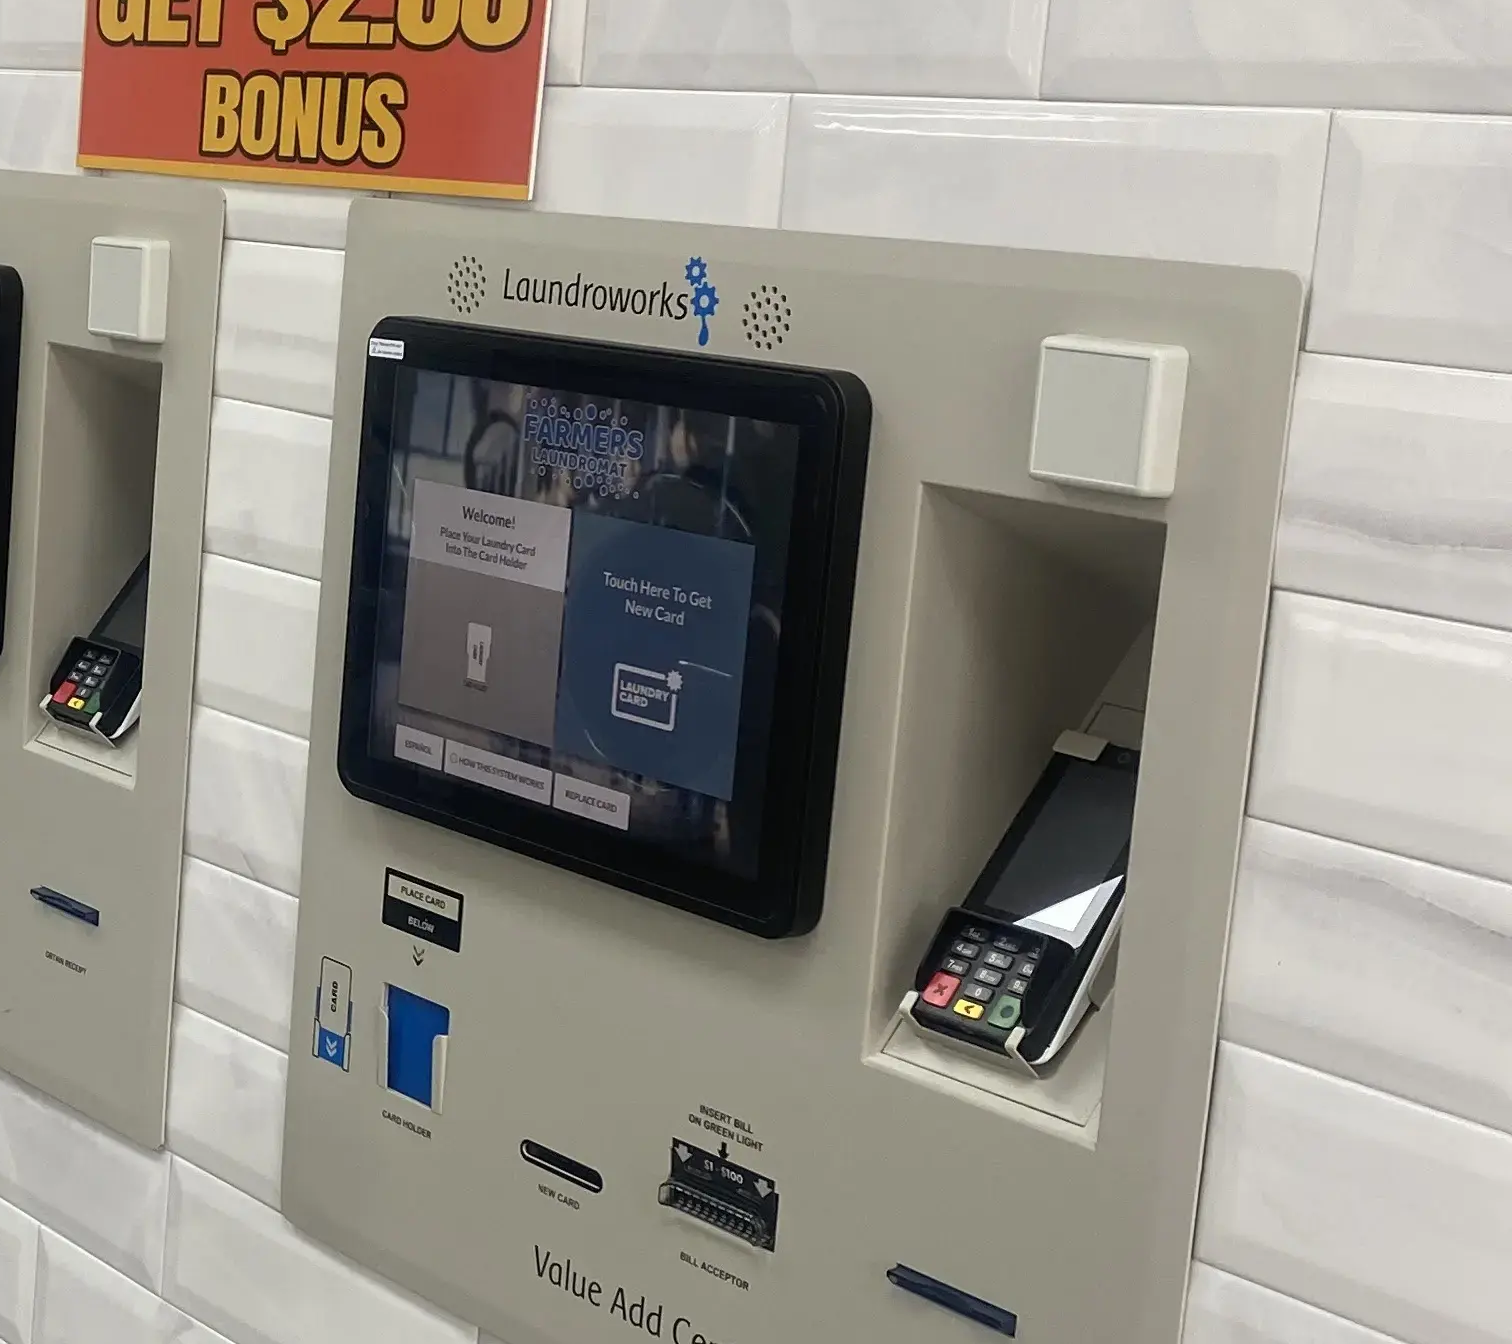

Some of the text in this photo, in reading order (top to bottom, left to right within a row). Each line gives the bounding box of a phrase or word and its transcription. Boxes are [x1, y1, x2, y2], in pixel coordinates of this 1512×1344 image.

[199, 69, 407, 168] BONUS
[502, 268, 688, 321] Laundroworks
[523, 412, 644, 460] FARMERS
[532, 446, 628, 478] LAUNDROMAT
[462, 505, 516, 530] Welcome!
[440, 526, 537, 557] Place Your Laundry Card
[445, 542, 528, 570] Into The Card Holder
[603, 571, 712, 609] Touch Here To Get
[625, 599, 685, 626] New Card
[619, 692, 648, 708] CARD
[620, 680, 670, 702] LAUNDRY
[458, 756, 545, 791] HOW THIS SYSTEM WORKS
[565, 789, 618, 813] REPLACE CARD
[400, 885, 446, 910] PLACE CARD
[408, 915, 435, 933] BELOW
[330, 980, 339, 1012] CARD
[382, 1109, 432, 1140] CARD HOLDER
[688, 1113, 764, 1152] ON GREEN LIGHT
[700, 1104, 754, 1134] INSERT BILL
[720, 1166, 744, 1185] $100
[537, 1183, 581, 1210] NEW CARD
[679, 1251, 750, 1291] BILL ACCEPTOR
[534, 1244, 603, 1307] Value
[609, 1287, 664, 1338] Add
